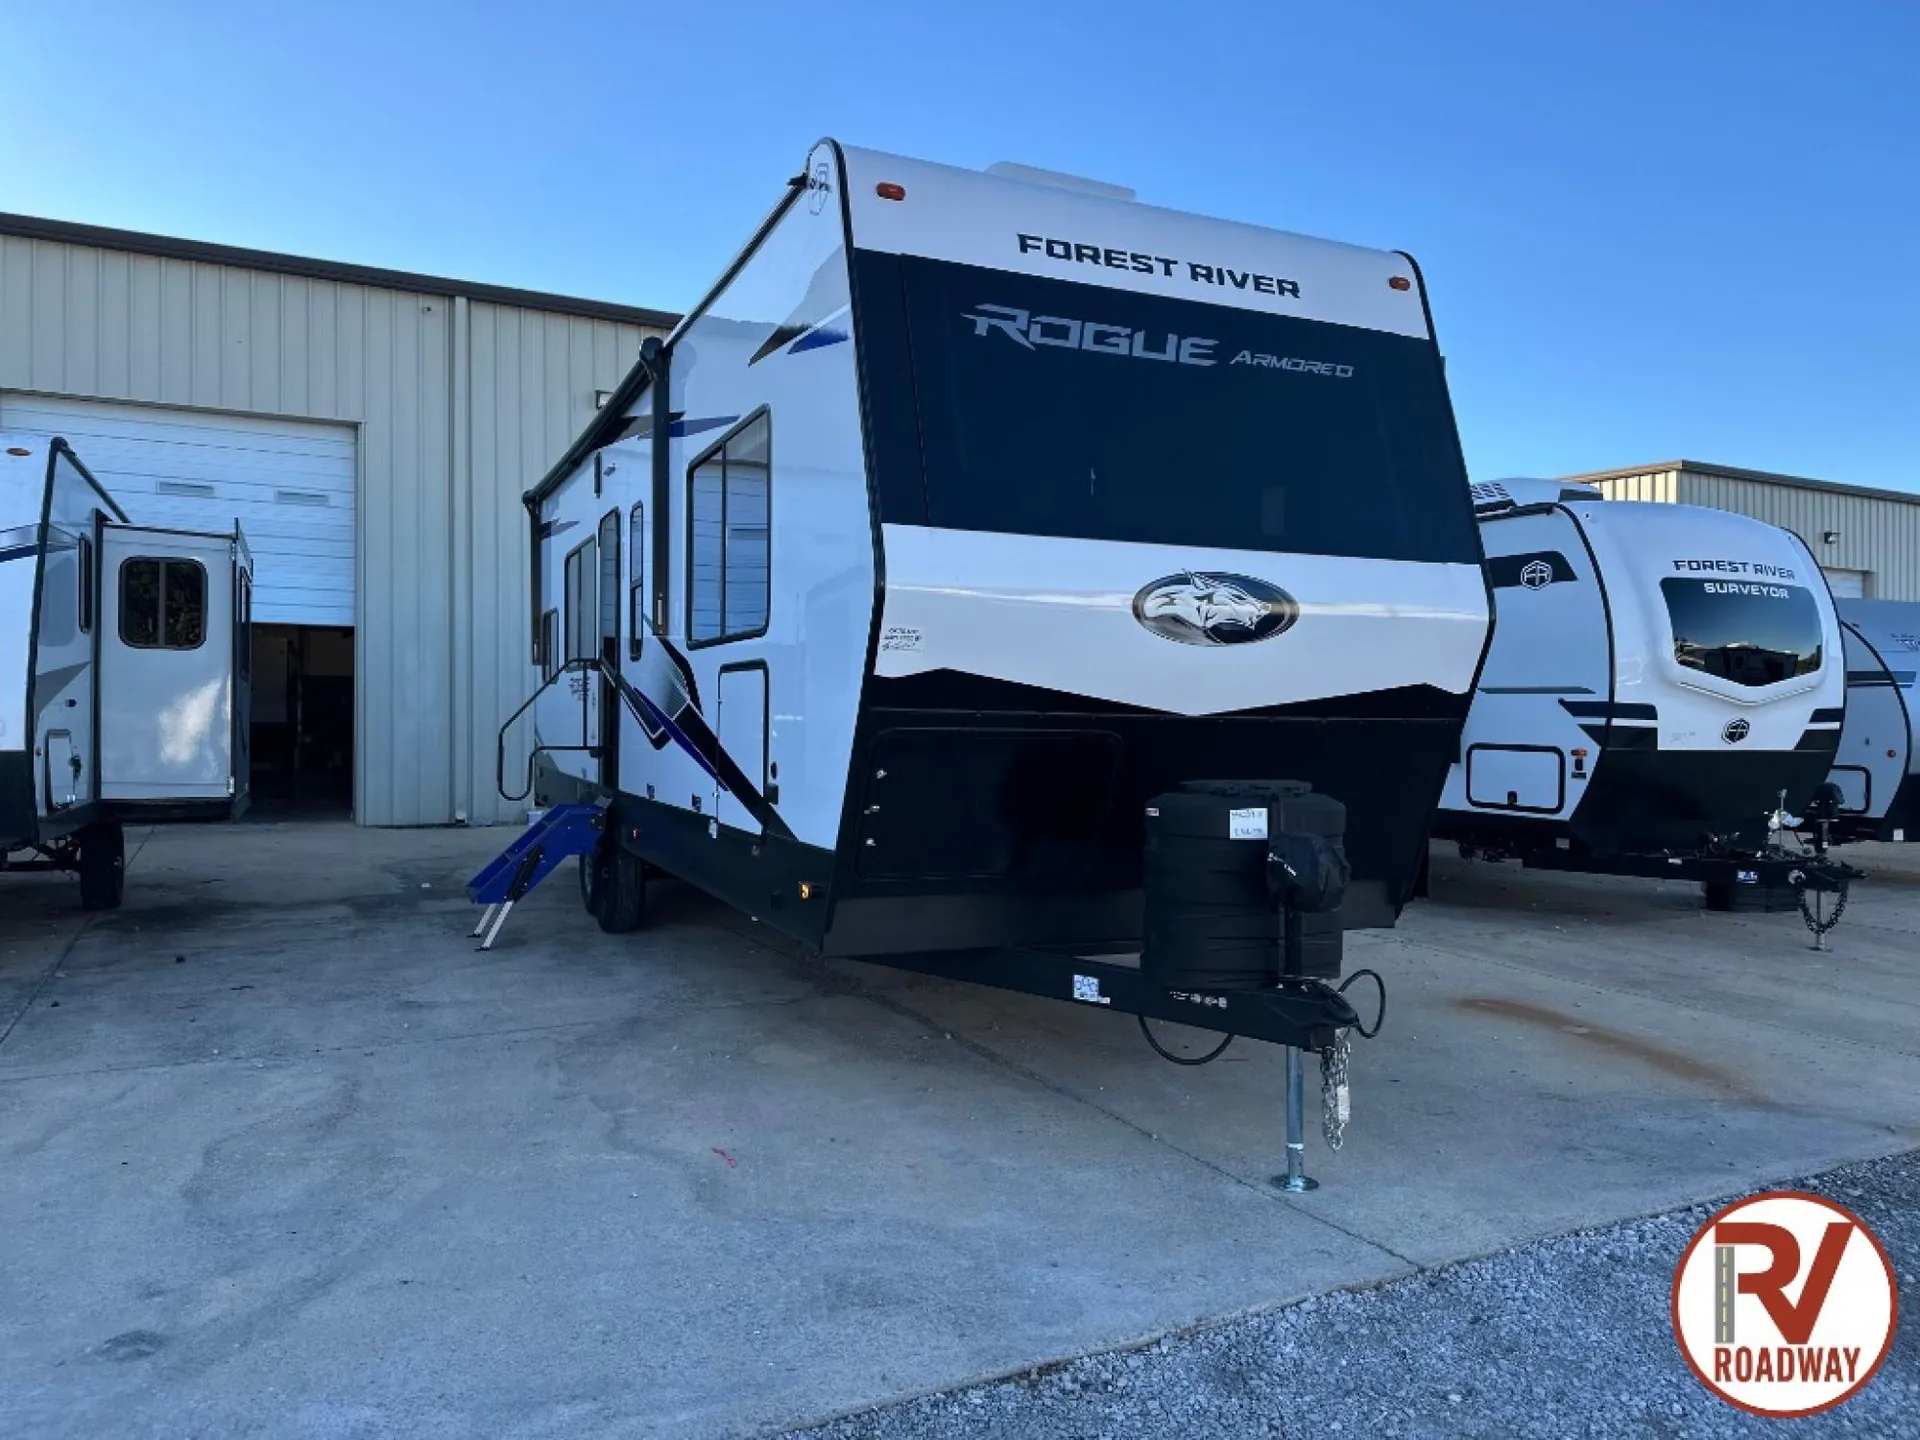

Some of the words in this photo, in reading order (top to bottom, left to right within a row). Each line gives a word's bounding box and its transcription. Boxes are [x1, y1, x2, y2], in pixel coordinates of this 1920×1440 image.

[1016, 232, 1178, 277] FOREST
[1187, 262, 1301, 299] RIVER
[960, 303, 1219, 366] ROGUE
[1230, 350, 1353, 378] ARMORED
[1672, 560, 1749, 573] FOREST
[1753, 563, 1795, 580] RIVER
[1703, 582, 1789, 599] SURVEYOR
